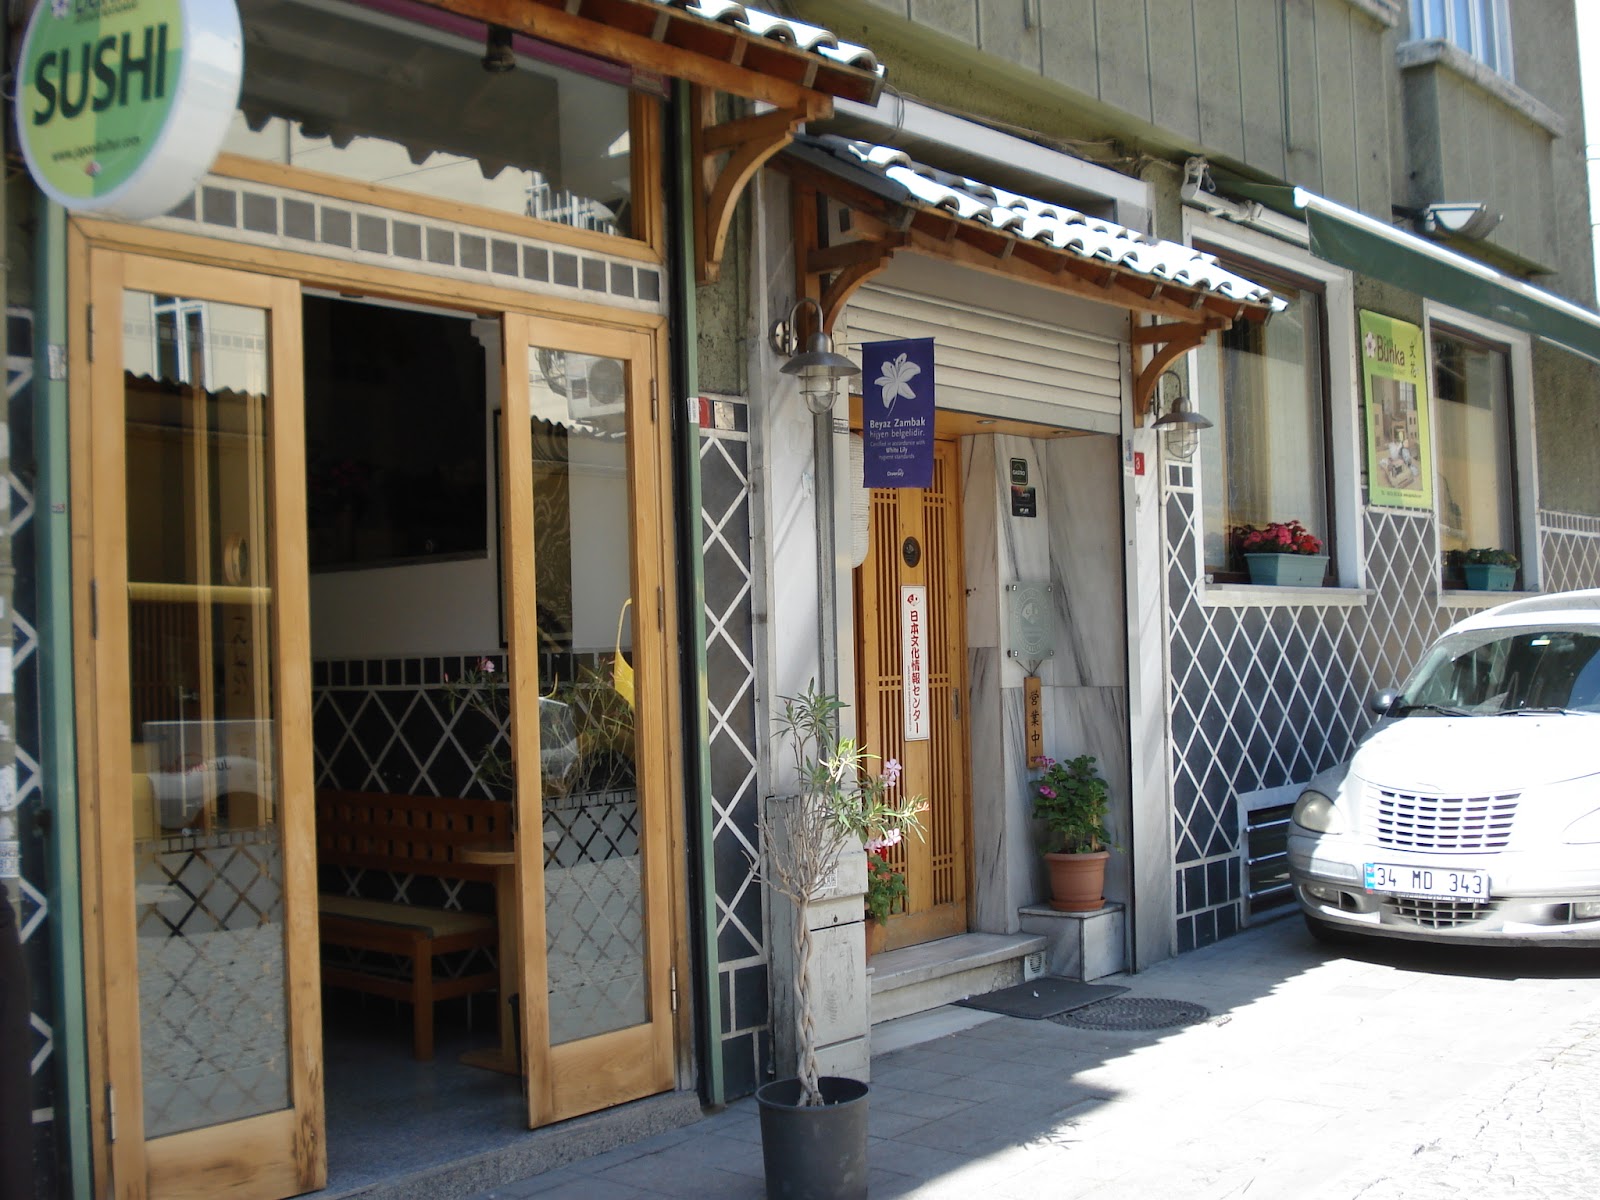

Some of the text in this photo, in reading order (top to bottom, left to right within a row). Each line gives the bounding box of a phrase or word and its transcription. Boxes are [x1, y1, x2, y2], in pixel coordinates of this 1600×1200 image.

[32, 23, 169, 126] SUSHI
[1377, 335, 1405, 366] Bunka
[870, 417, 926, 430] Beyaz Zambak
[891, 429, 926, 439] belgelidir.
[900, 446, 908, 455] Lily
[910, 610, 921, 734] 日本文化情報センター
[1376, 867, 1482, 894] 34 MD 343
